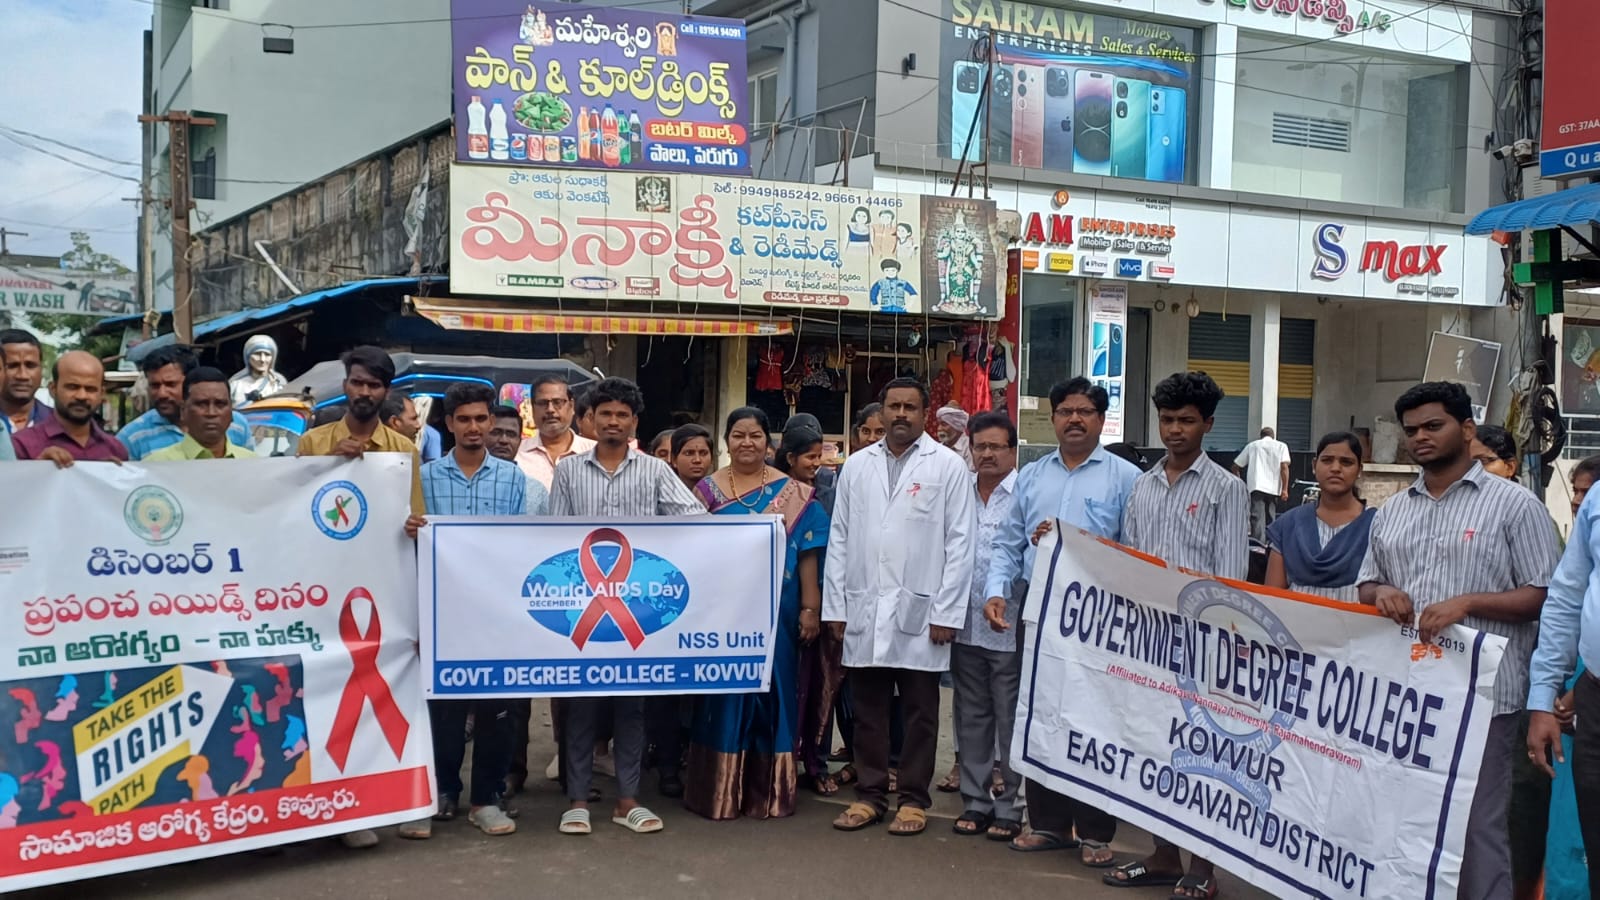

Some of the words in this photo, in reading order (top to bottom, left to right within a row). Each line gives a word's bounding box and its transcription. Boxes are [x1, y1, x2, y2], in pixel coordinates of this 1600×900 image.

[952, 0, 1094, 44] SAIRAM
[1122, 20, 1172, 41] Mobiles
[1358, 10, 1391, 31] A/C
[555, 14, 651, 57] మహేశ్వరి
[954, 25, 1093, 57] ENERPRISES
[1100, 36, 1132, 55] Sales
[1135, 45, 1144, 56] &
[1147, 44, 1197, 64] Services
[465, 44, 537, 92] పాన్
[545, 61, 571, 94] &
[650, 121, 693, 138] బటర్
[697, 124, 737, 145] మిల్క్
[1559, 123, 1577, 134] GST:
[649, 143, 690, 165] పాలు,
[693, 146, 738, 166] పెరుగు
[739, 185, 822, 203] 9949485242,
[865, 195, 903, 208] 44466
[728, 237, 747, 256] &
[1083, 236, 1111, 247] Mobiles
[1117, 239, 1134, 249] Sales
[1315, 223, 1349, 279] S
[1090, 260, 1108, 268] iPhone
[1120, 262, 1142, 271] vivo
[508, 277, 563, 287] RAMRAJ
[13, 292, 65, 309] WASH
[86, 543, 213, 577] డిసెంబర్
[228, 548, 244, 573] 1
[526, 581, 587, 598] World
[592, 581, 642, 598] AIDS
[648, 582, 685, 600] Day
[24, 589, 139, 636] ప్రపంచ
[148, 583, 252, 621] ఎయిడ్స్
[254, 582, 329, 612] దినం
[18, 643, 56, 666] నా
[65, 629, 180, 663] ఆరోగ్యం
[219, 631, 249, 649] నా
[255, 621, 324, 652] హక్కు
[678, 632, 719, 649] NSS
[726, 631, 765, 648] Unit
[1438, 636, 1465, 653] 2019
[439, 667, 498, 687] GOVT.
[503, 665, 581, 685] DEGREE
[586, 664, 675, 684] COLLEGE
[1060, 581, 1211, 683] GOVERNMENT
[1216, 627, 1316, 720] DEGREE
[1317, 660, 1444, 769] COLLEGE
[1148, 679, 1157, 689] to
[86, 701, 135, 740] TAKE
[139, 676, 176, 709] THE
[93, 691, 204, 787] RIGHTS
[1168, 717, 1285, 792] KOVVUR
[99, 774, 145, 814] PATH
[1067, 730, 1135, 780] EAST
[1139, 758, 1259, 840] GODAVARI
[1260, 811, 1375, 898] DISTRICT
[19, 822, 133, 861] సామాజిక
[138, 808, 210, 850] ఆరోగ్య
